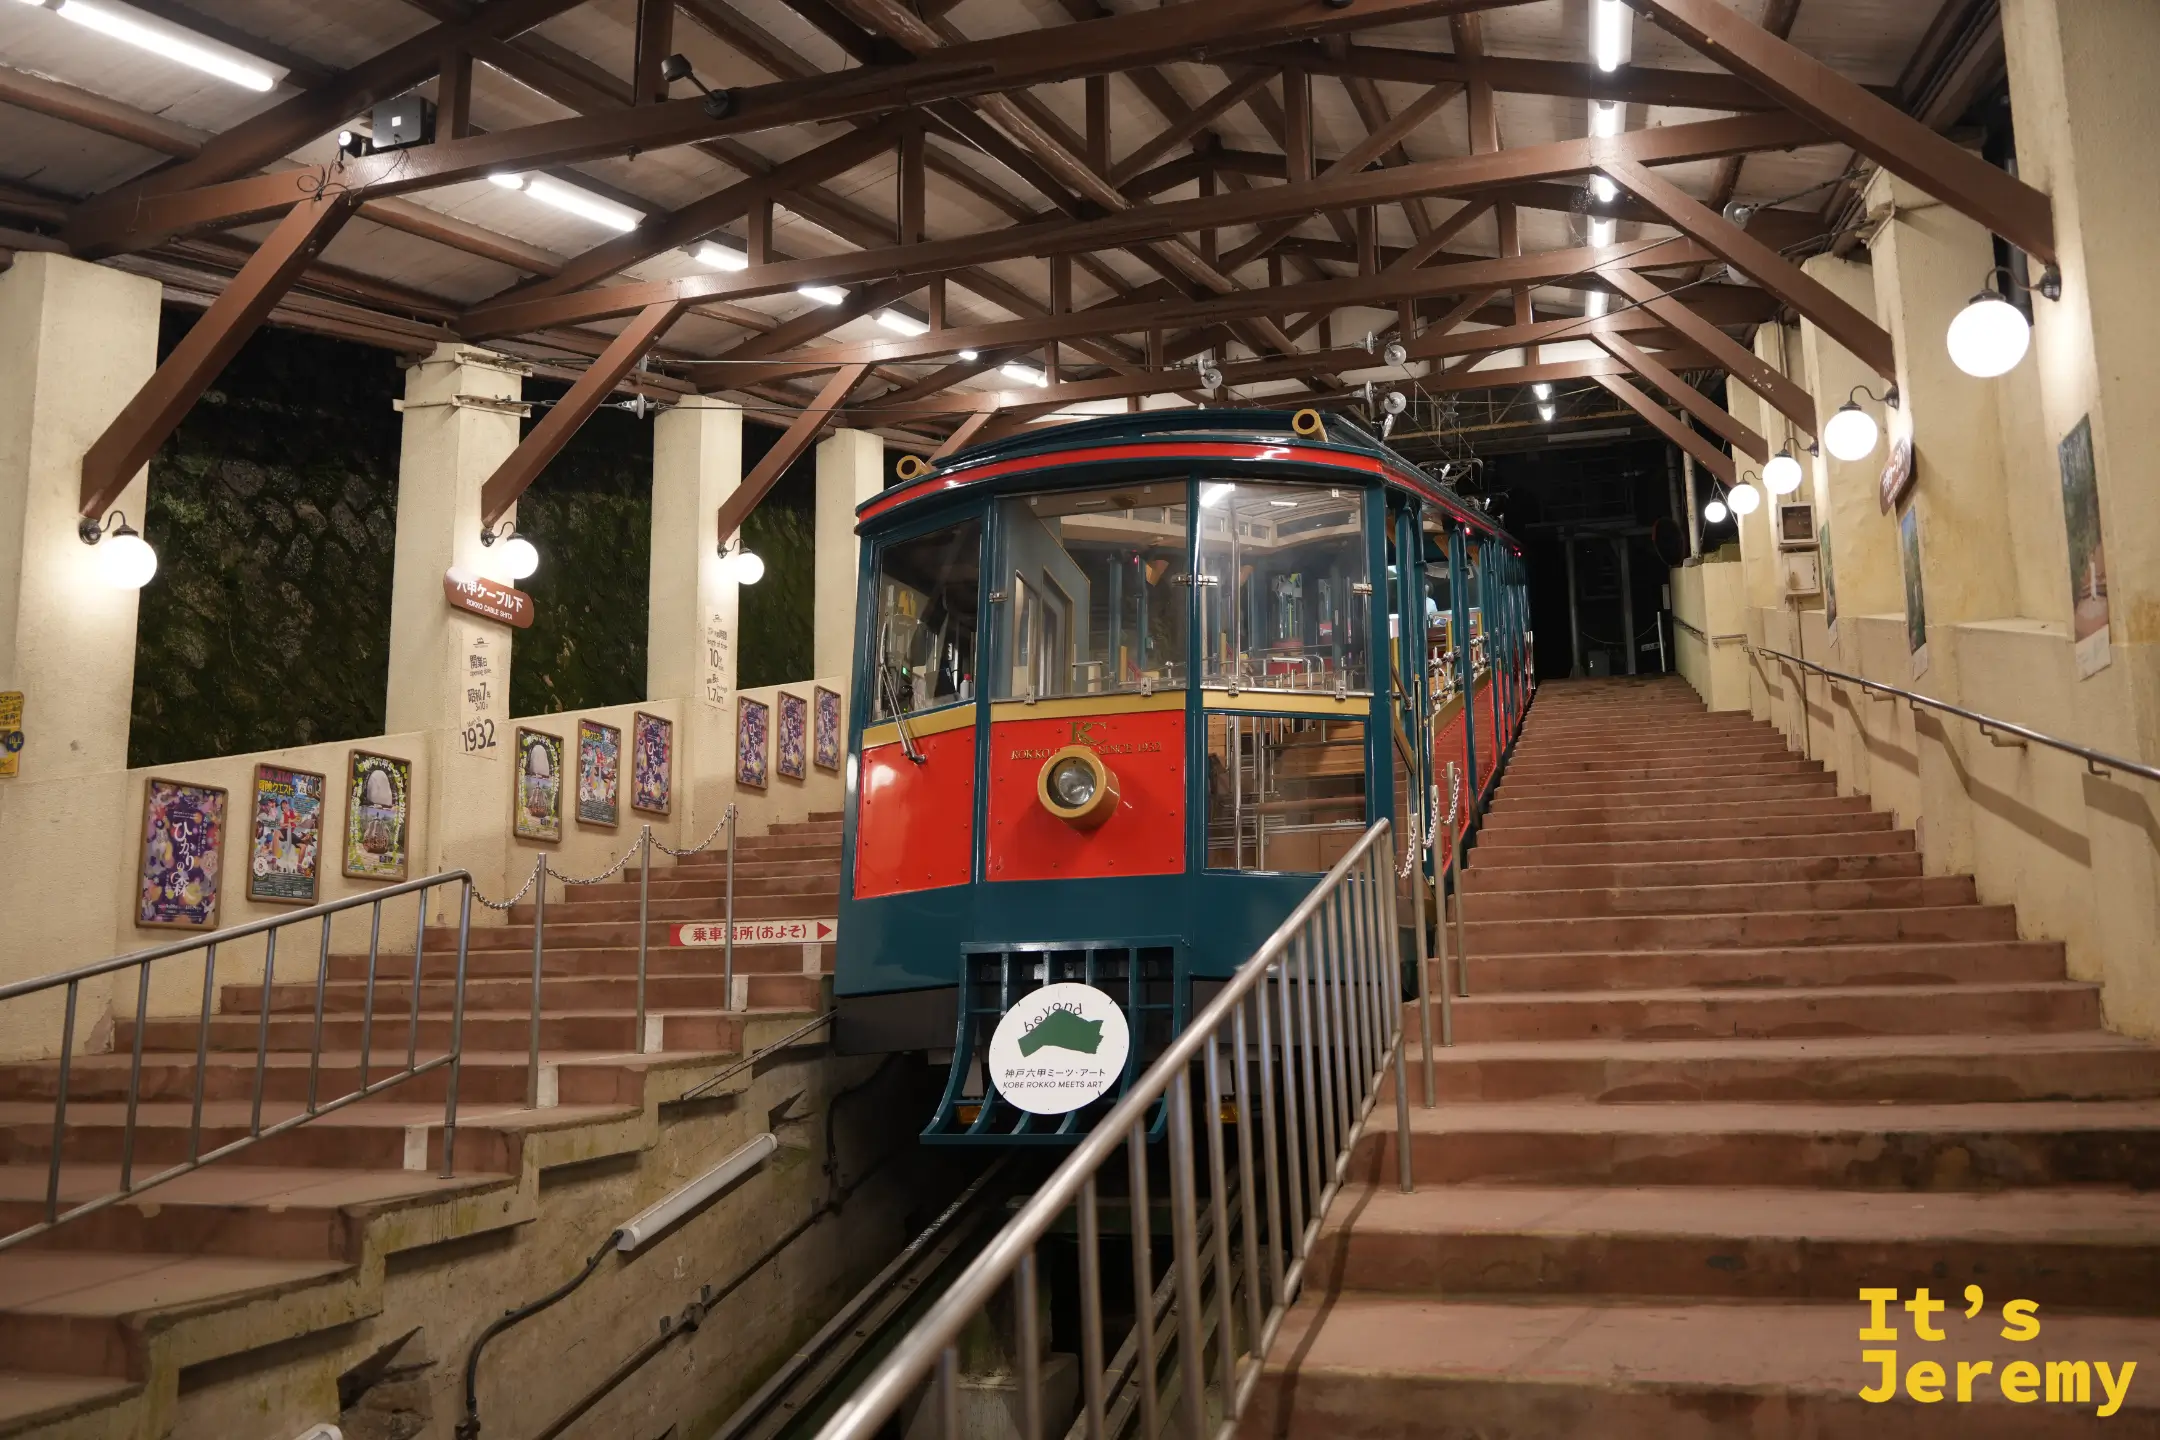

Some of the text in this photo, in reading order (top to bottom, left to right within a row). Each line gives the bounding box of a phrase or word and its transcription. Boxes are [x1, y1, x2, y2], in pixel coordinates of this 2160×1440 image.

[462, 719, 496, 752] 1932
[1011, 749, 1051, 761] ROKKO
[1098, 742, 1161, 755] SINCE 1932
[171, 821, 195, 899] ひかりの森
[1024, 1002, 1083, 1033] beyond
[1004, 1068, 1106, 1078] 神戸六甲ミーツ・アート
[1003, 1081, 1024, 1089] KOBE
[1026, 1081, 1056, 1089] ROKKO
[1058, 1081, 1085, 1089] MEETS
